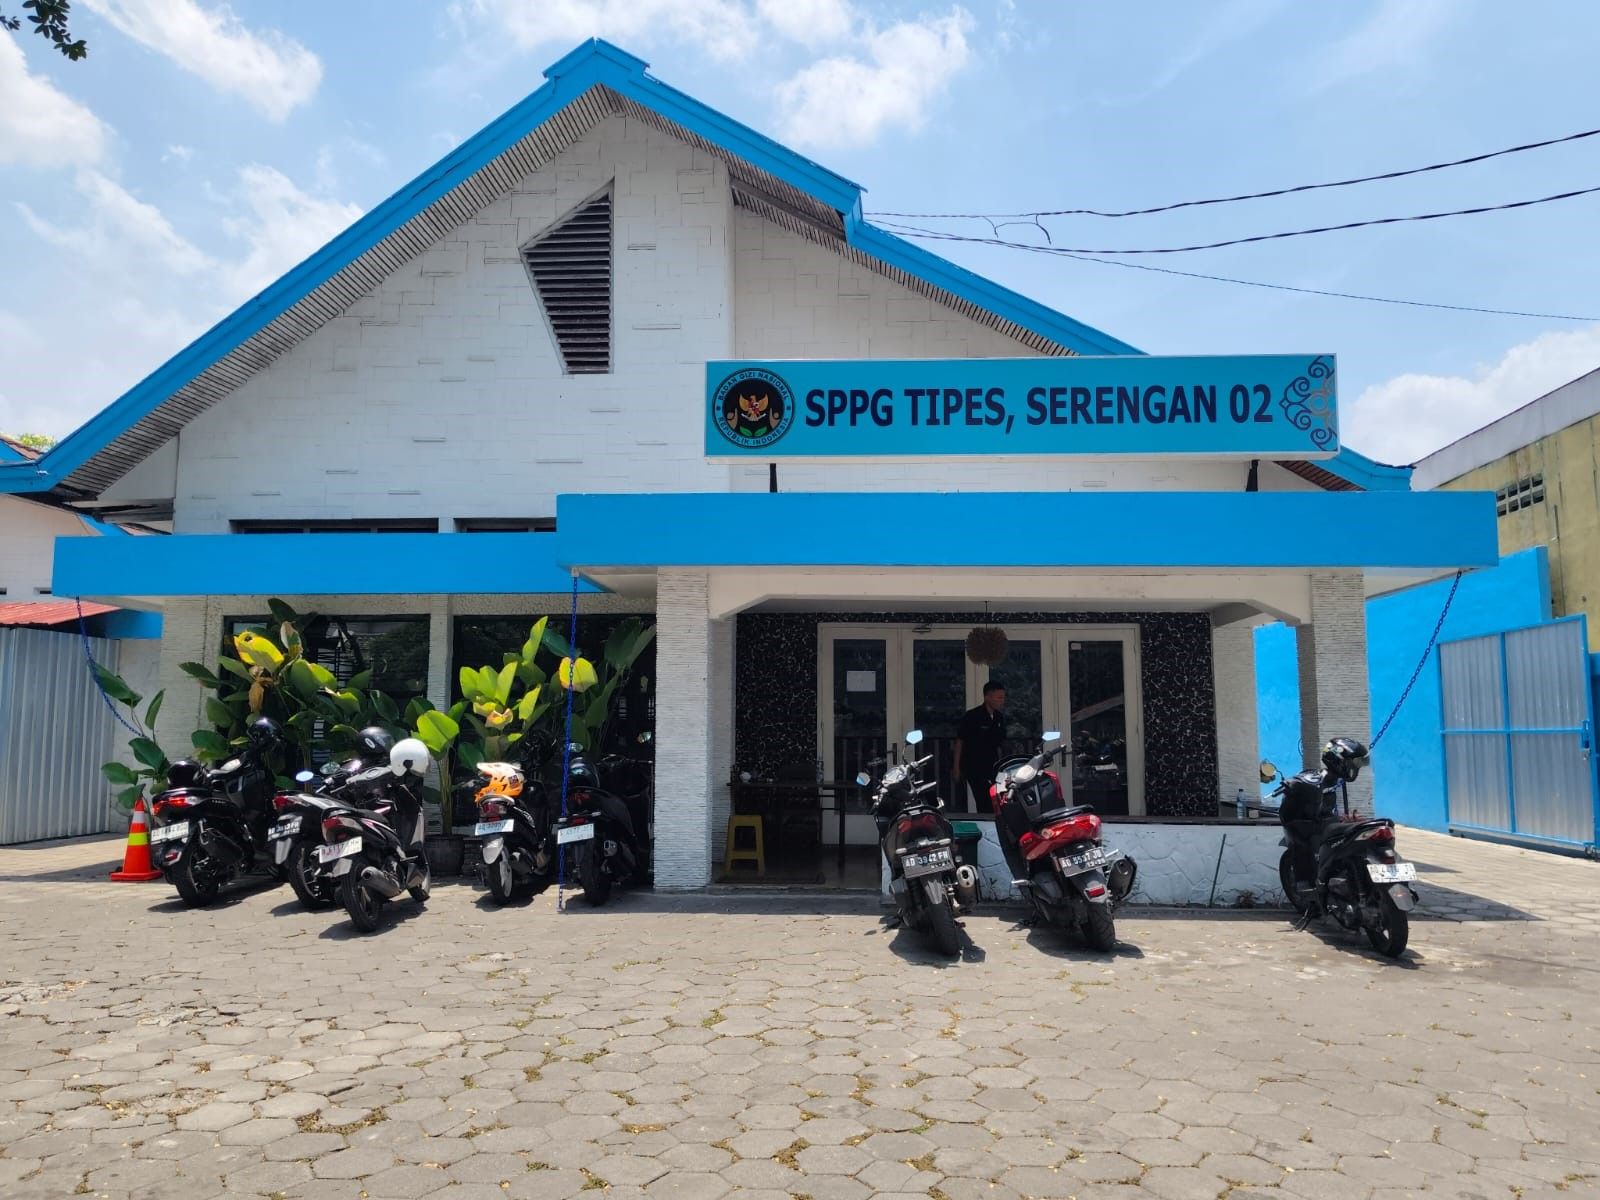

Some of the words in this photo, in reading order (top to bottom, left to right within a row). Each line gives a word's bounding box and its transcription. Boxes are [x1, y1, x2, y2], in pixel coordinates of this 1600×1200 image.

[718, 377, 738, 400] BADAN
[739, 372, 756, 380] GIZI
[757, 371, 789, 400] NASIONAL
[805, 388, 893, 427] SPPG
[904, 387, 1014, 434] TIPES,
[1026, 385, 1217, 425] SERENGAN
[1229, 384, 1273, 423] 02
[718, 416, 750, 445] REPUBLIK
[751, 417, 789, 445] INDONESIA
[905, 857, 916, 867] AD
